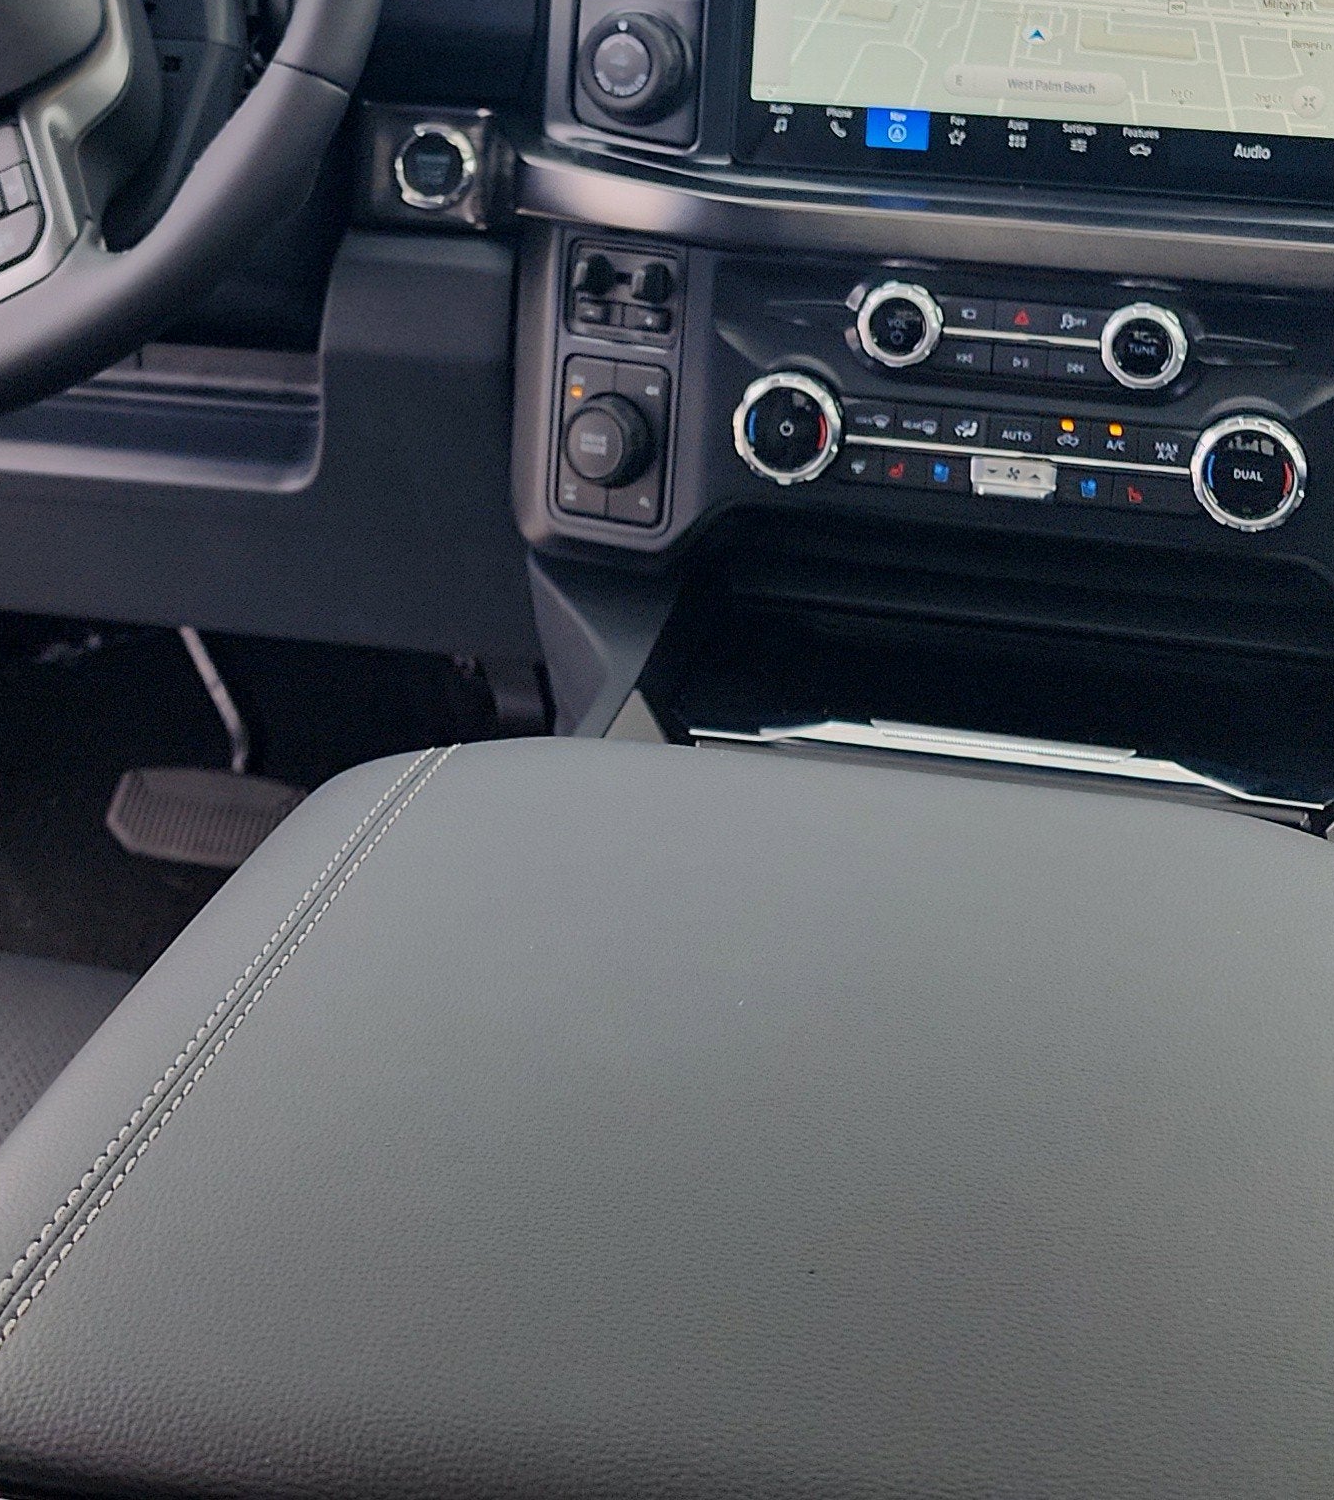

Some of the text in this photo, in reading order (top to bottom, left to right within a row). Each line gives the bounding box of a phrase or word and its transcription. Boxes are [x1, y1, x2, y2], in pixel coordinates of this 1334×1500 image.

[1007, 78, 1096, 95] West Palm Beach
[1233, 142, 1272, 161] Audio
[1127, 343, 1158, 357] TUNE
[1001, 430, 1033, 443] AUTO
[1105, 439, 1126, 452] A/C
[1154, 441, 1180, 454] MAX
[1233, 467, 1265, 483] DUAL
